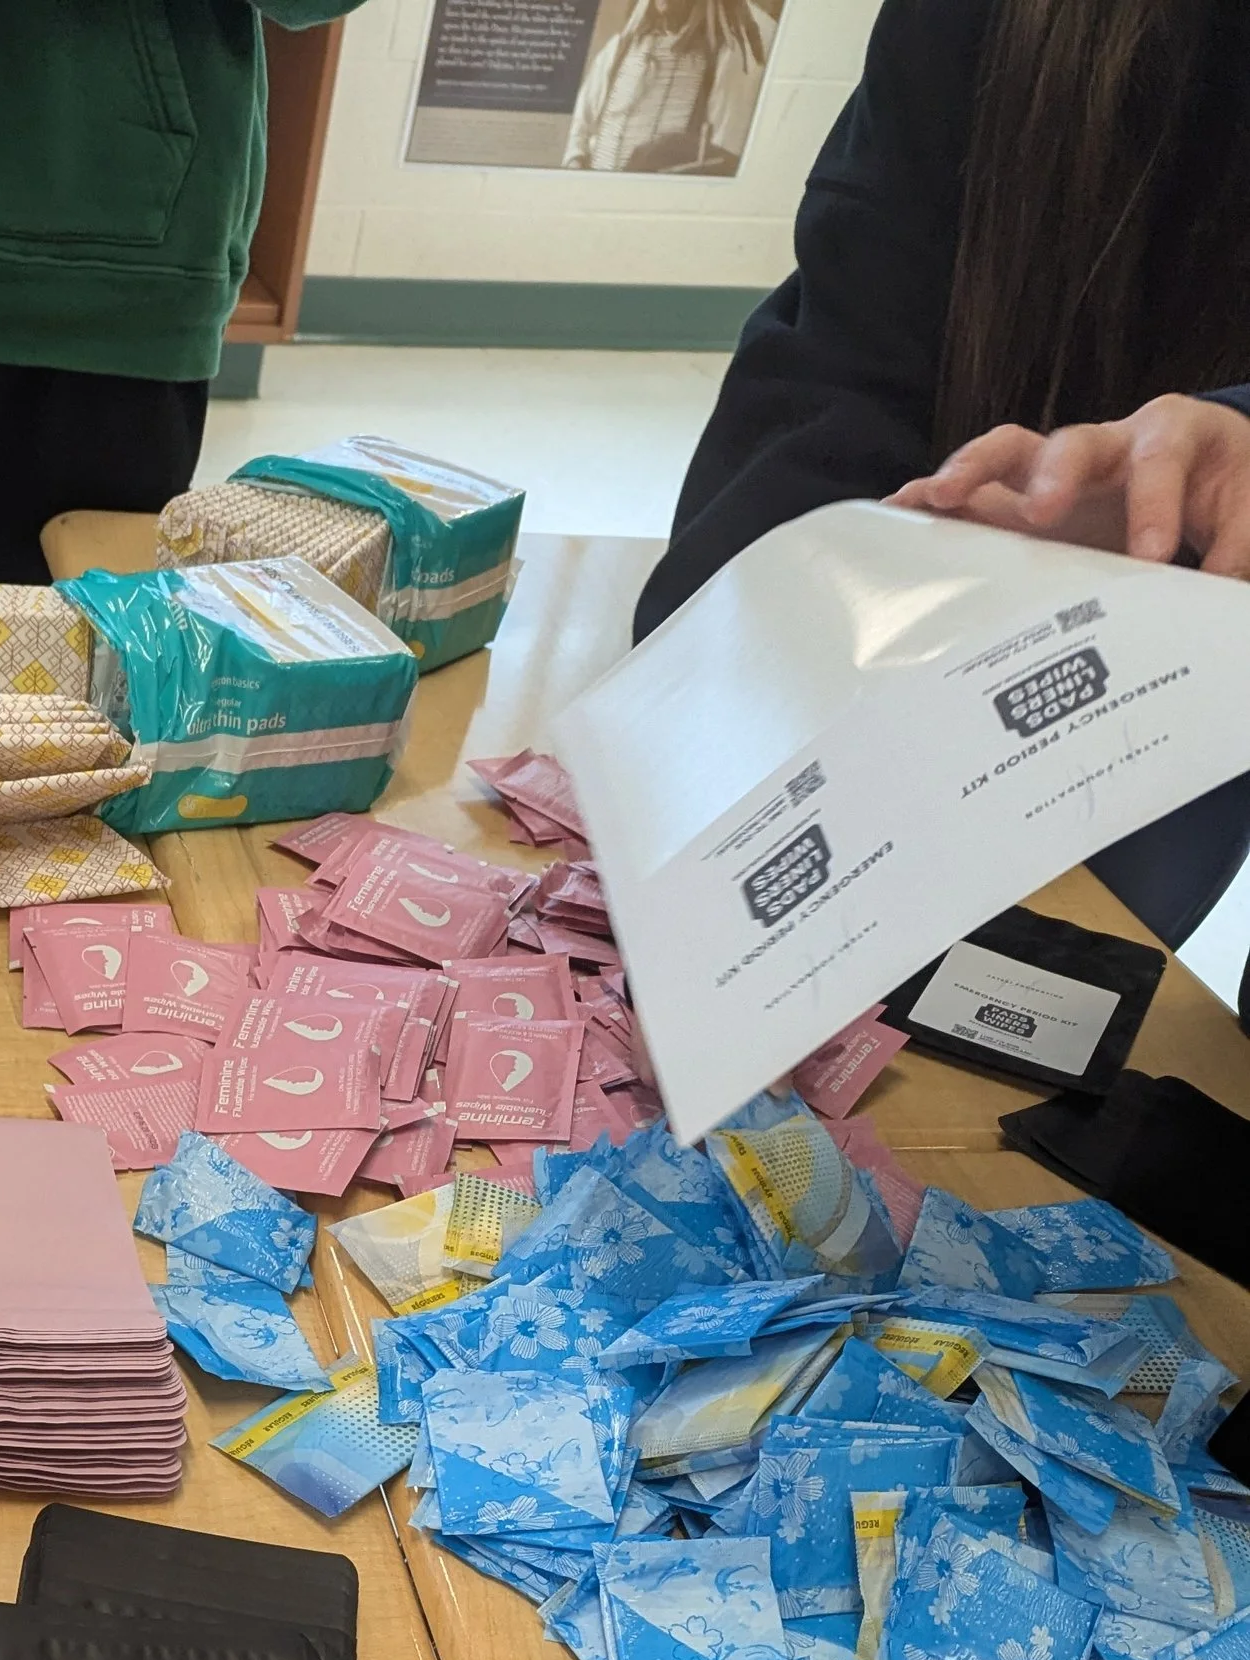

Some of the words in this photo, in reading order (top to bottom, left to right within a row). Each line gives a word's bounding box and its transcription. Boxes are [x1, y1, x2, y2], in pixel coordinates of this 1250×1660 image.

[1007, 655, 1087, 704] WIPES
[1010, 666, 1097, 721] LINERS
[1067, 665, 1191, 735] EMERGENCY
[212, 711, 241, 729] thin
[246, 713, 287, 734] pads
[1026, 683, 1094, 729] PADS
[993, 731, 1061, 776] PERIOD
[961, 772, 989, 800] KIT
[347, 865, 385, 912] Feminine
[233, 998, 262, 1049] Feminine
[953, 983, 1018, 1009] EMERGENCY
[1020, 1006, 1058, 1023] PERIOD
[1060, 1017, 1079, 1028] KIT
[983, 1016, 1025, 1035] WIPES
[985, 1011, 1030, 1030] LINERS
[991, 1006, 1028, 1023] PADS
[215, 1059, 234, 1114] Feminine
[829, 1037, 881, 1093] Feminine
[455, 1101, 491, 1110] Wipes
[457, 1112, 546, 1129] Feminine
